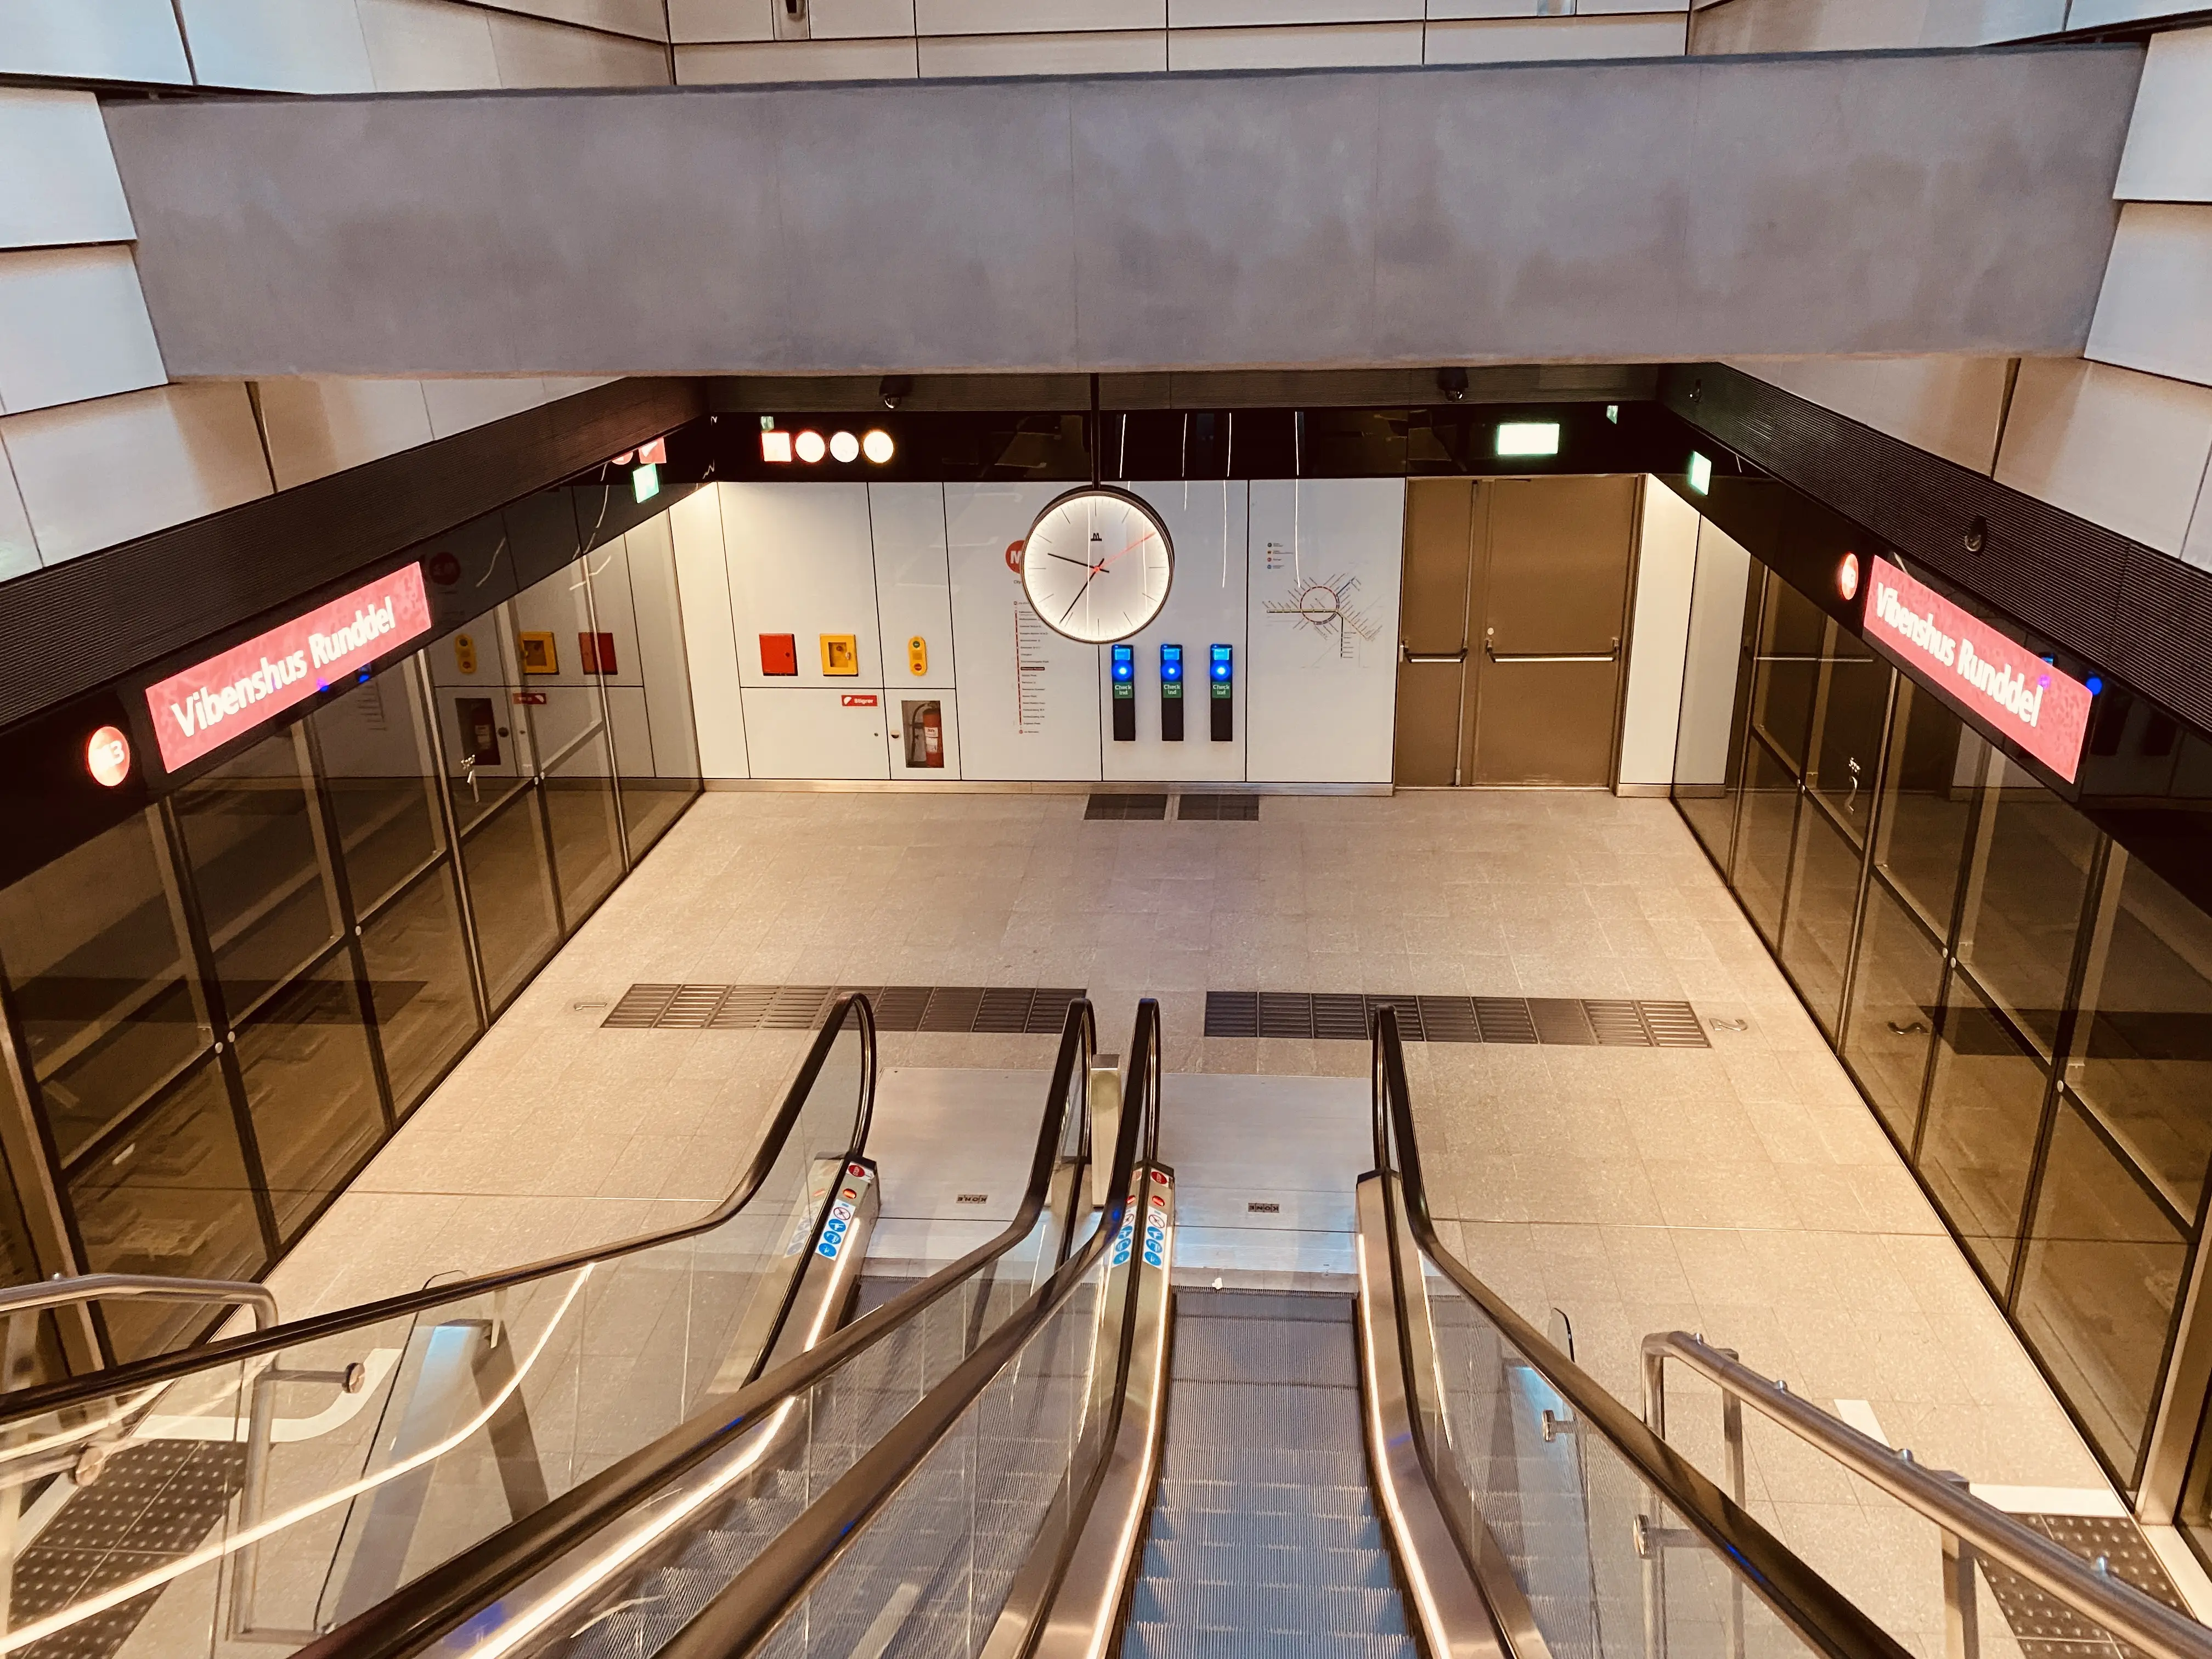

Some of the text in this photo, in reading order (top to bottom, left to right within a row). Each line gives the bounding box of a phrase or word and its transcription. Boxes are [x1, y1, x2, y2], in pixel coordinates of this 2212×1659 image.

[171, 596, 396, 737] Vibenshus Runddel
[1876, 582, 2044, 727] Vibenshus Runddel
